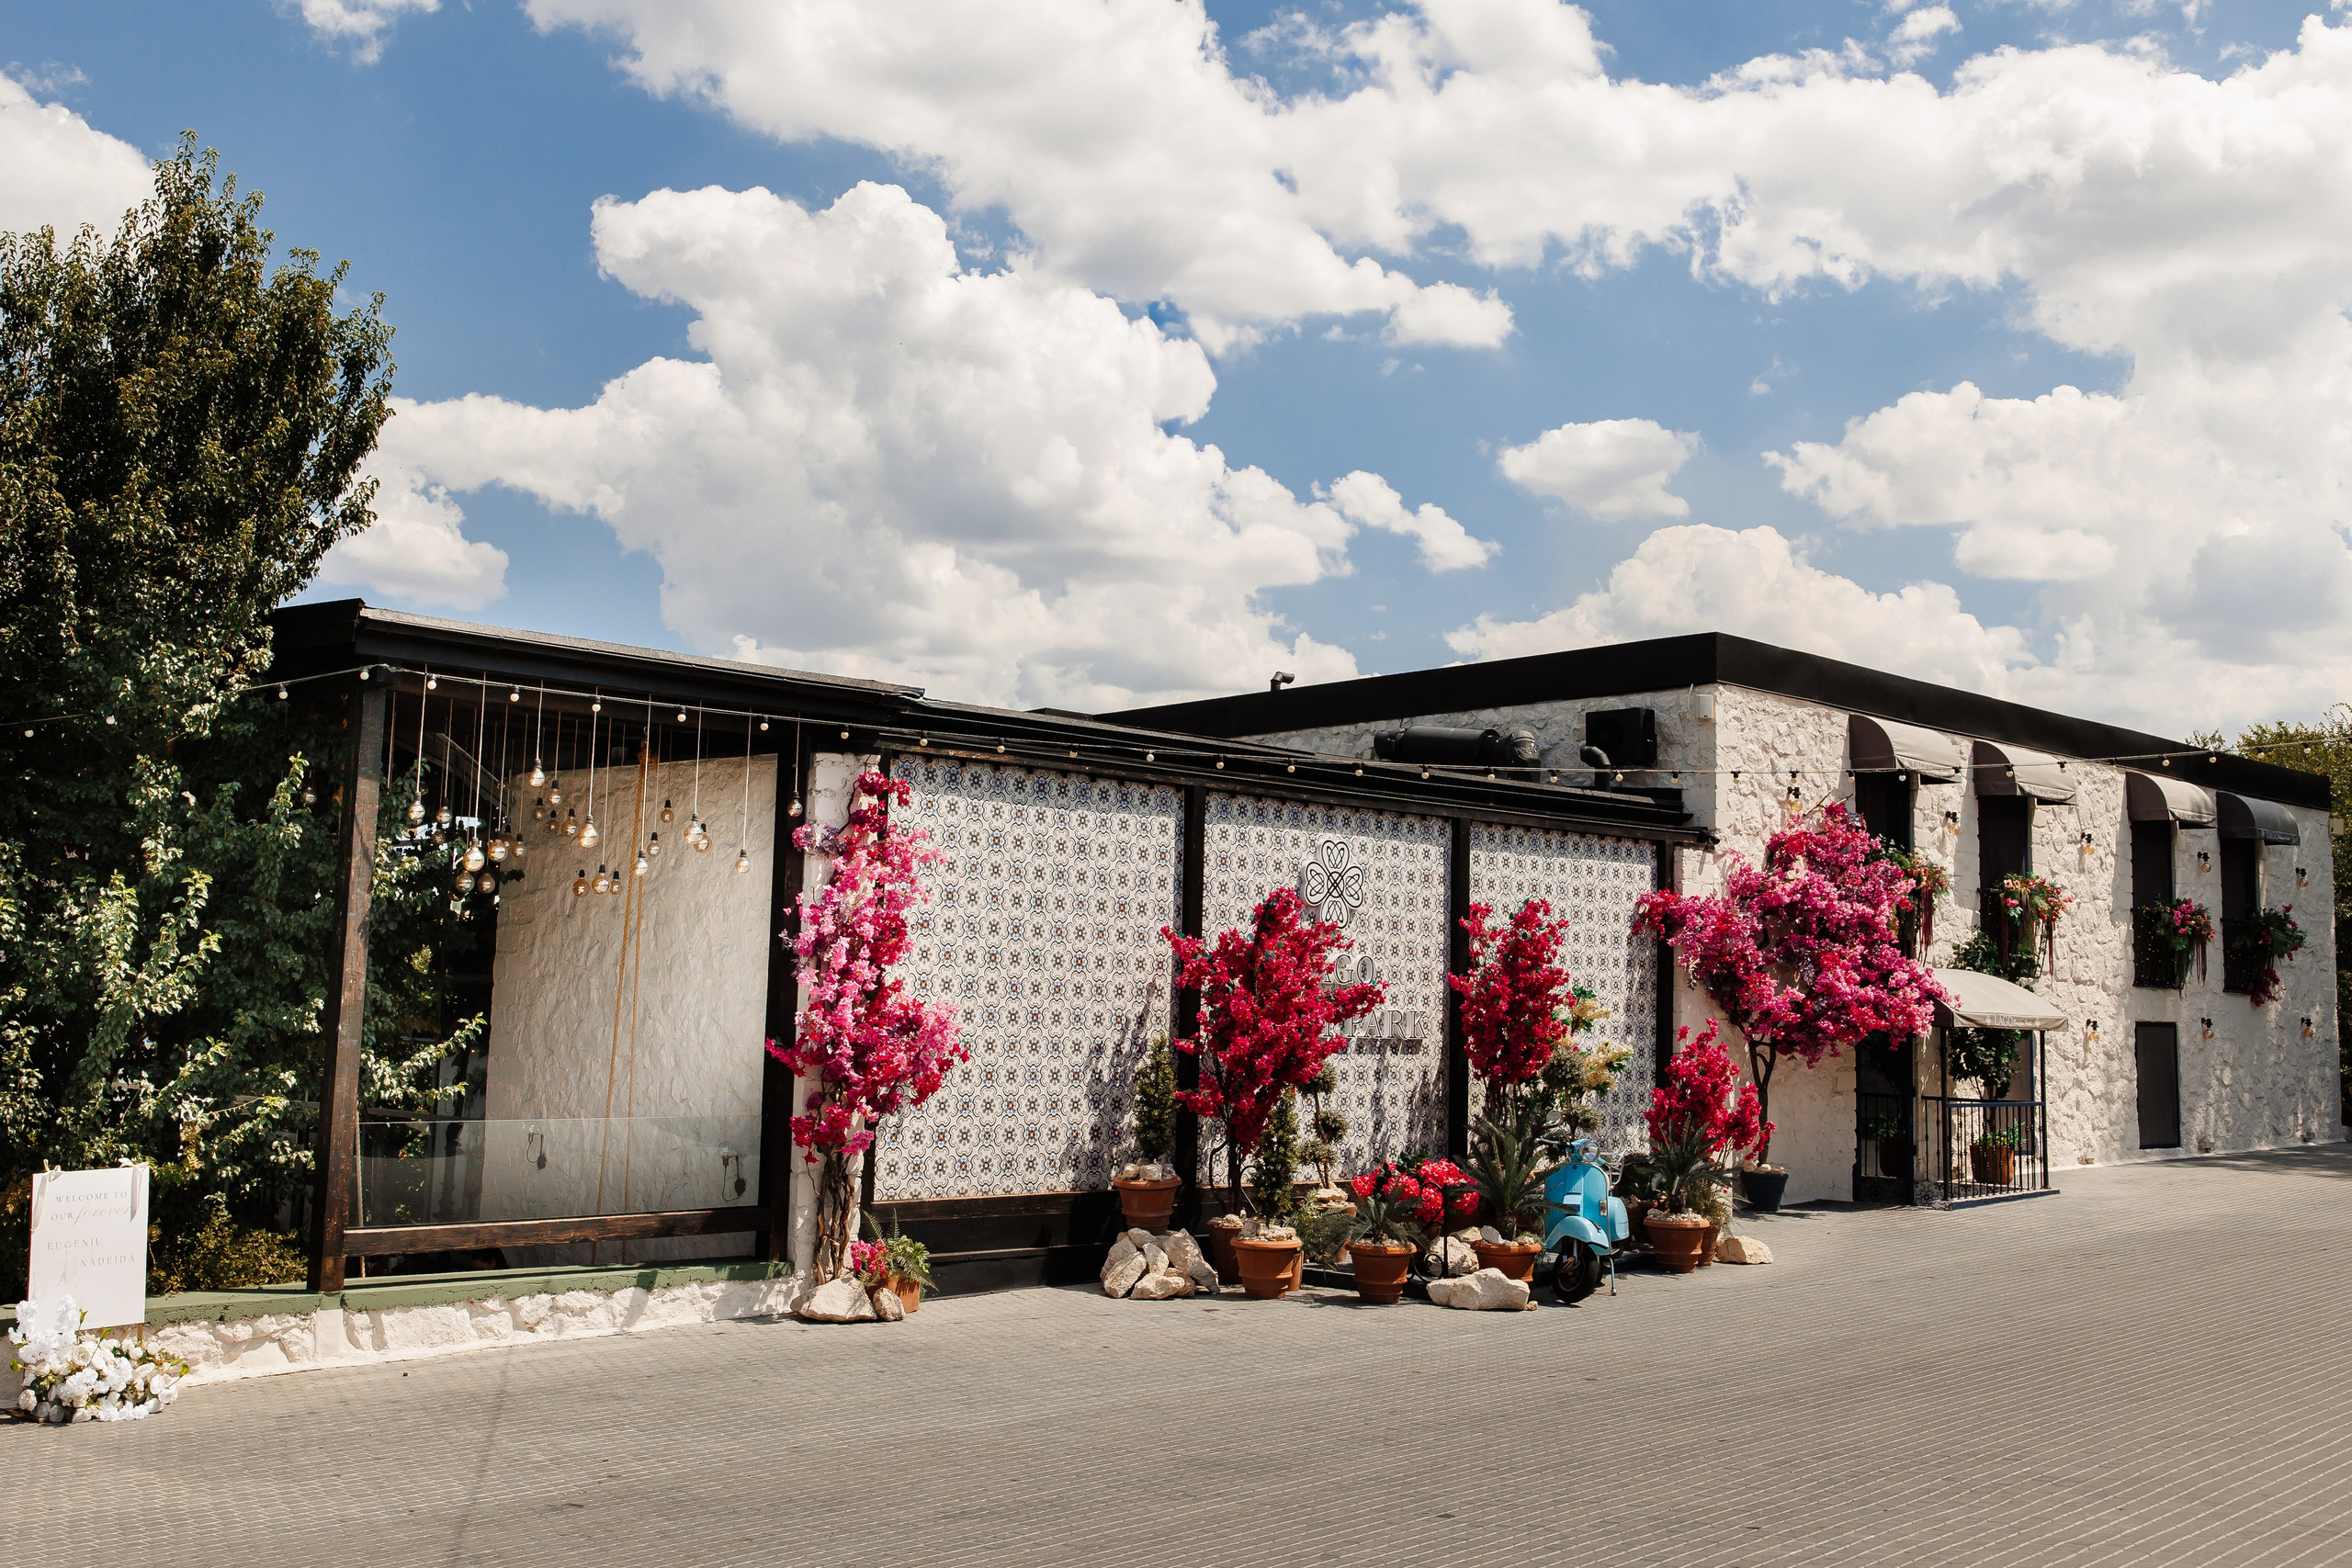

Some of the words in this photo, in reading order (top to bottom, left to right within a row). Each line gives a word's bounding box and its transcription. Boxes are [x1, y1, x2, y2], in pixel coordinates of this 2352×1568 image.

[1346, 1009, 1429, 1040] PARK
[1994, 1015, 2013, 1026] LAGO
[55, 1192, 108, 1202] WELCOME
[51, 1212, 74, 1222] OUR
[47, 1237, 102, 1250] EUGENIU
[81, 1255, 135, 1267] NADEJDA
